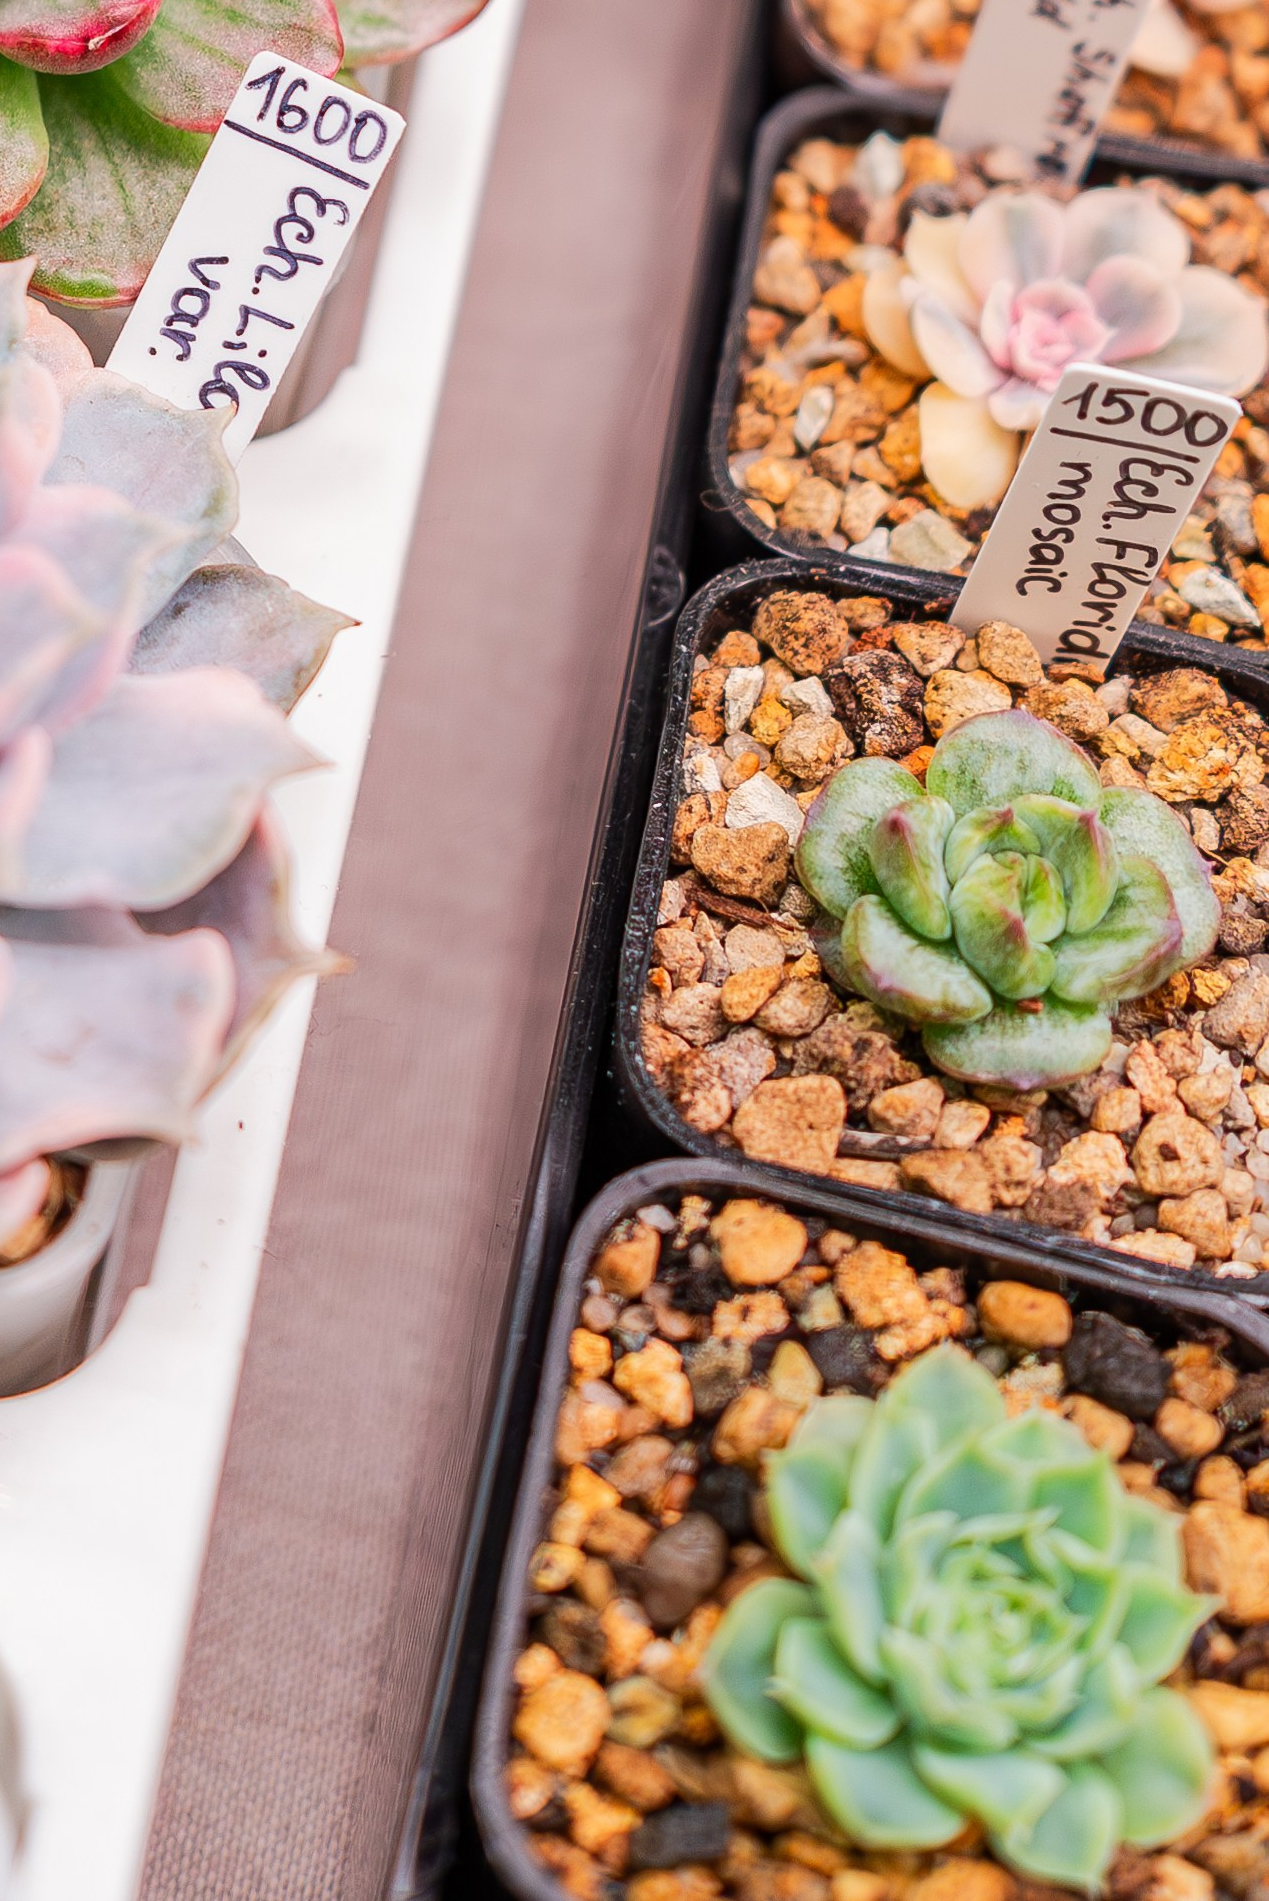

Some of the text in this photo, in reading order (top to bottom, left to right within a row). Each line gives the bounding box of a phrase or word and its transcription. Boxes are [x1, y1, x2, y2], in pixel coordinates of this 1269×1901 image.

[245, 65, 389, 164] 1600
[250, 185, 350, 295] Ech.
[147, 254, 230, 362] var.
[1061, 381, 1228, 448] 1500
[1015, 460, 1093, 597] mosaic
[1101, 457, 1194, 530] Ech.
